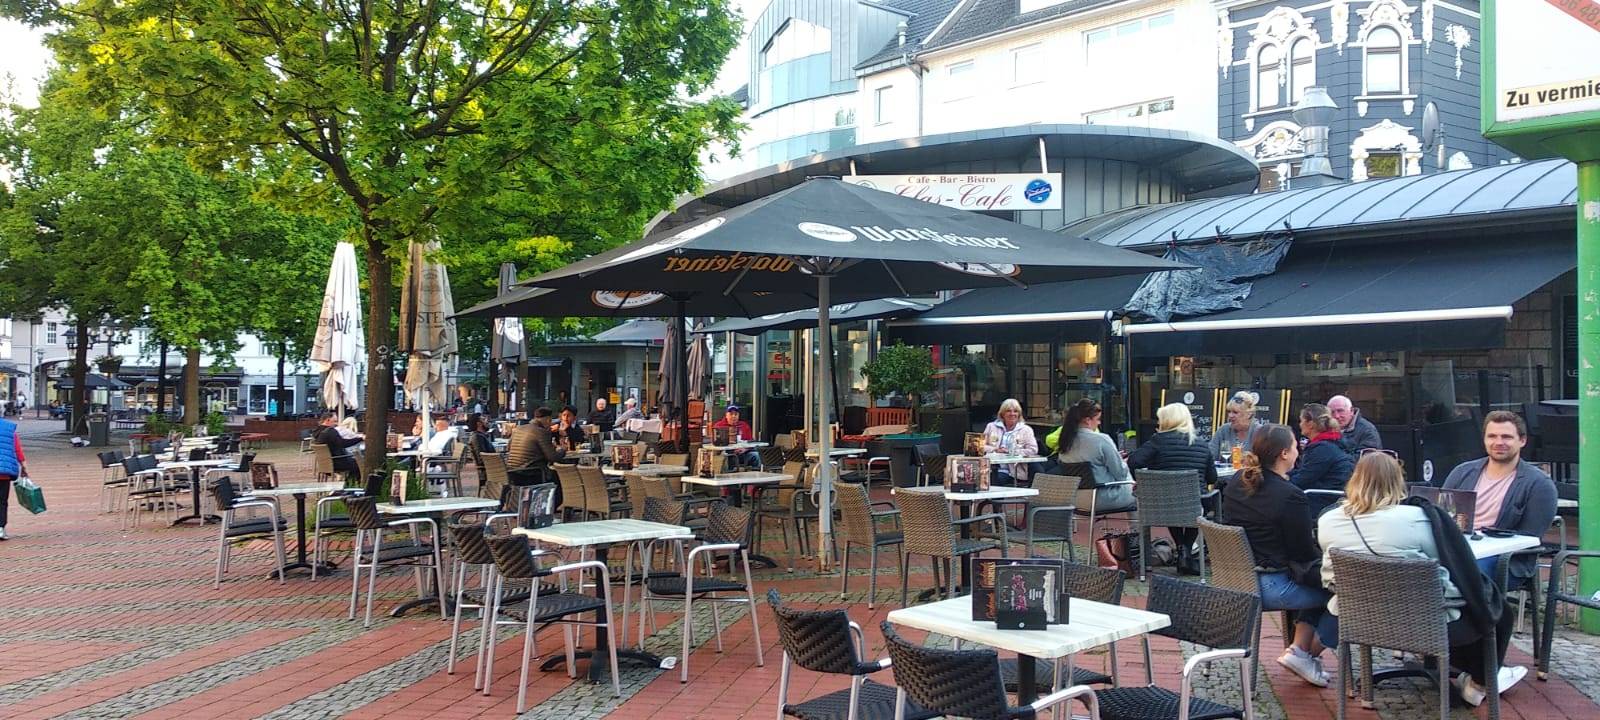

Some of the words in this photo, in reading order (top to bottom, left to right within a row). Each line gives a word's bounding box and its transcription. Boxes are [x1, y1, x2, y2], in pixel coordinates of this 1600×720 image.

[1506, 91, 1530, 108] Zu
[908, 176, 930, 184] Cafe
[940, 176, 958, 184] Bar
[967, 175, 996, 183] Bistro
[851, 225, 1020, 250] Warsteiner
